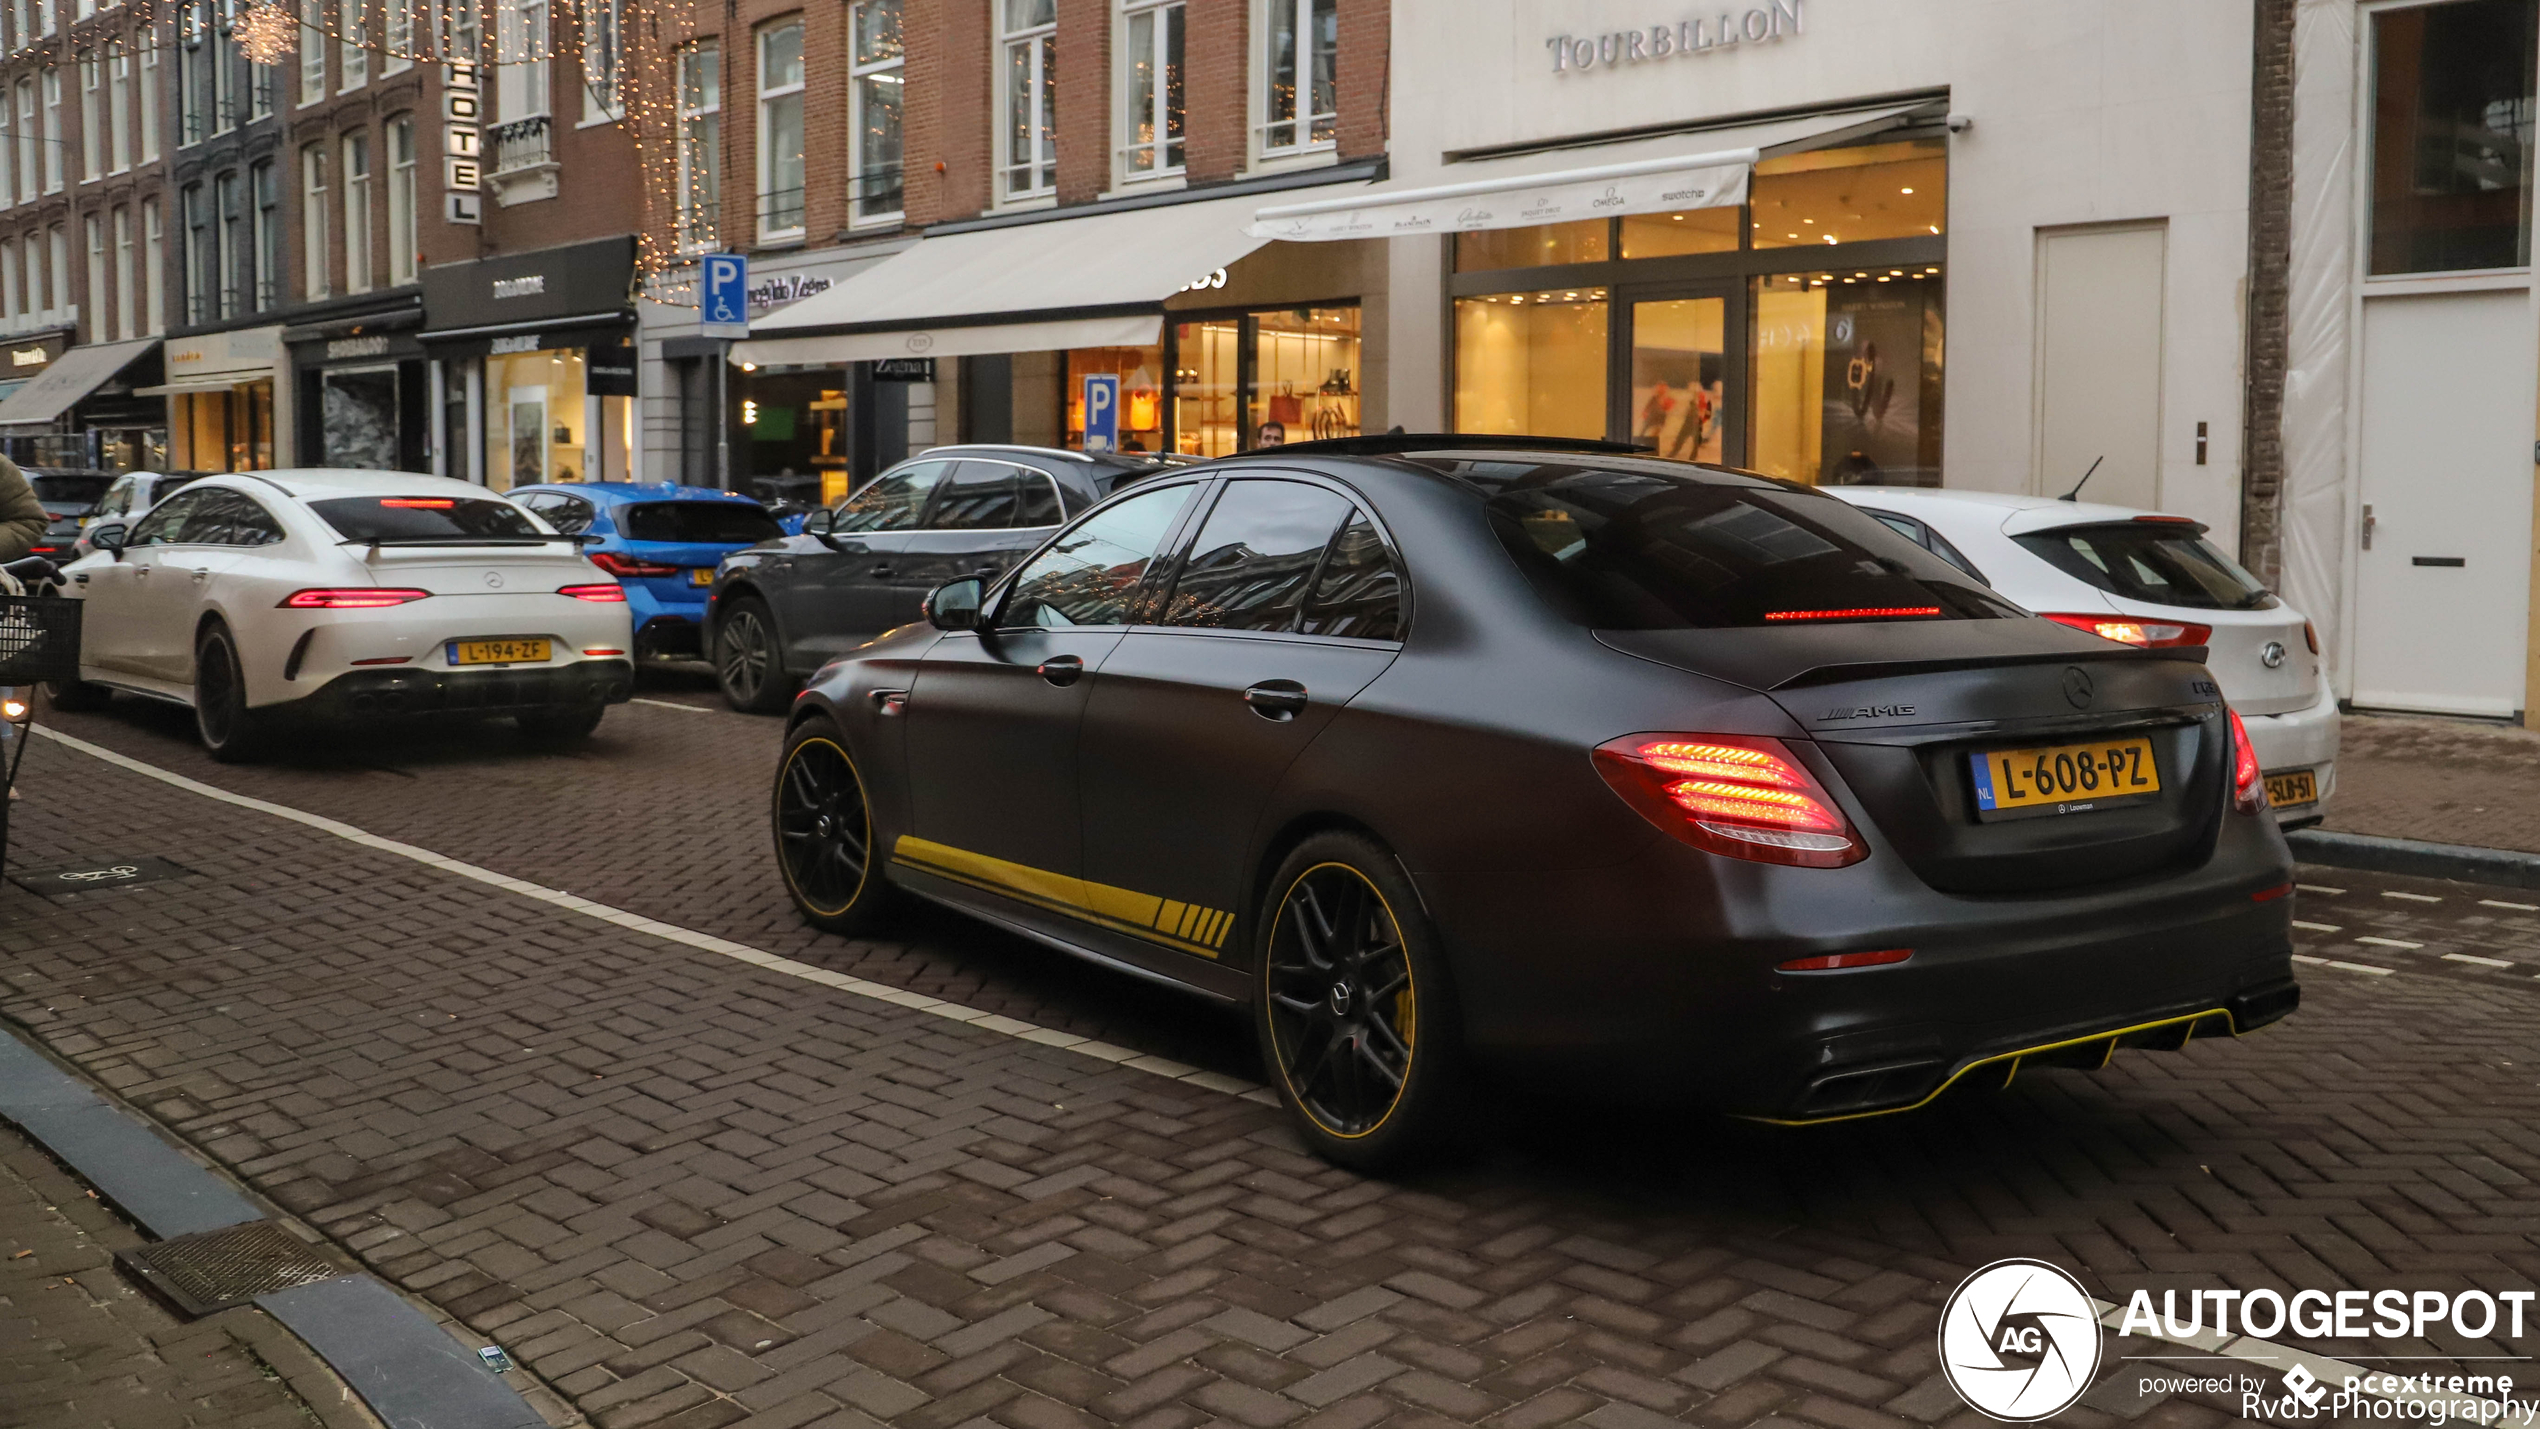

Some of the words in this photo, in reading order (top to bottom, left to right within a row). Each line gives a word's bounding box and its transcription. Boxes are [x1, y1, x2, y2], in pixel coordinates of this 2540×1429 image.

[450, 63, 476, 219] HOTEL
[1593, 197, 1625, 208] OMEGA
[1662, 190, 1698, 201] swatch
[711, 260, 738, 295] P
[468, 642, 540, 661] L-194-ZF
[1848, 704, 1916, 719] AMG
[2002, 747, 2148, 799] L-608-PZ
[1977, 787, 1993, 800] NL
[2265, 776, 2311, 802] -SLB-51
